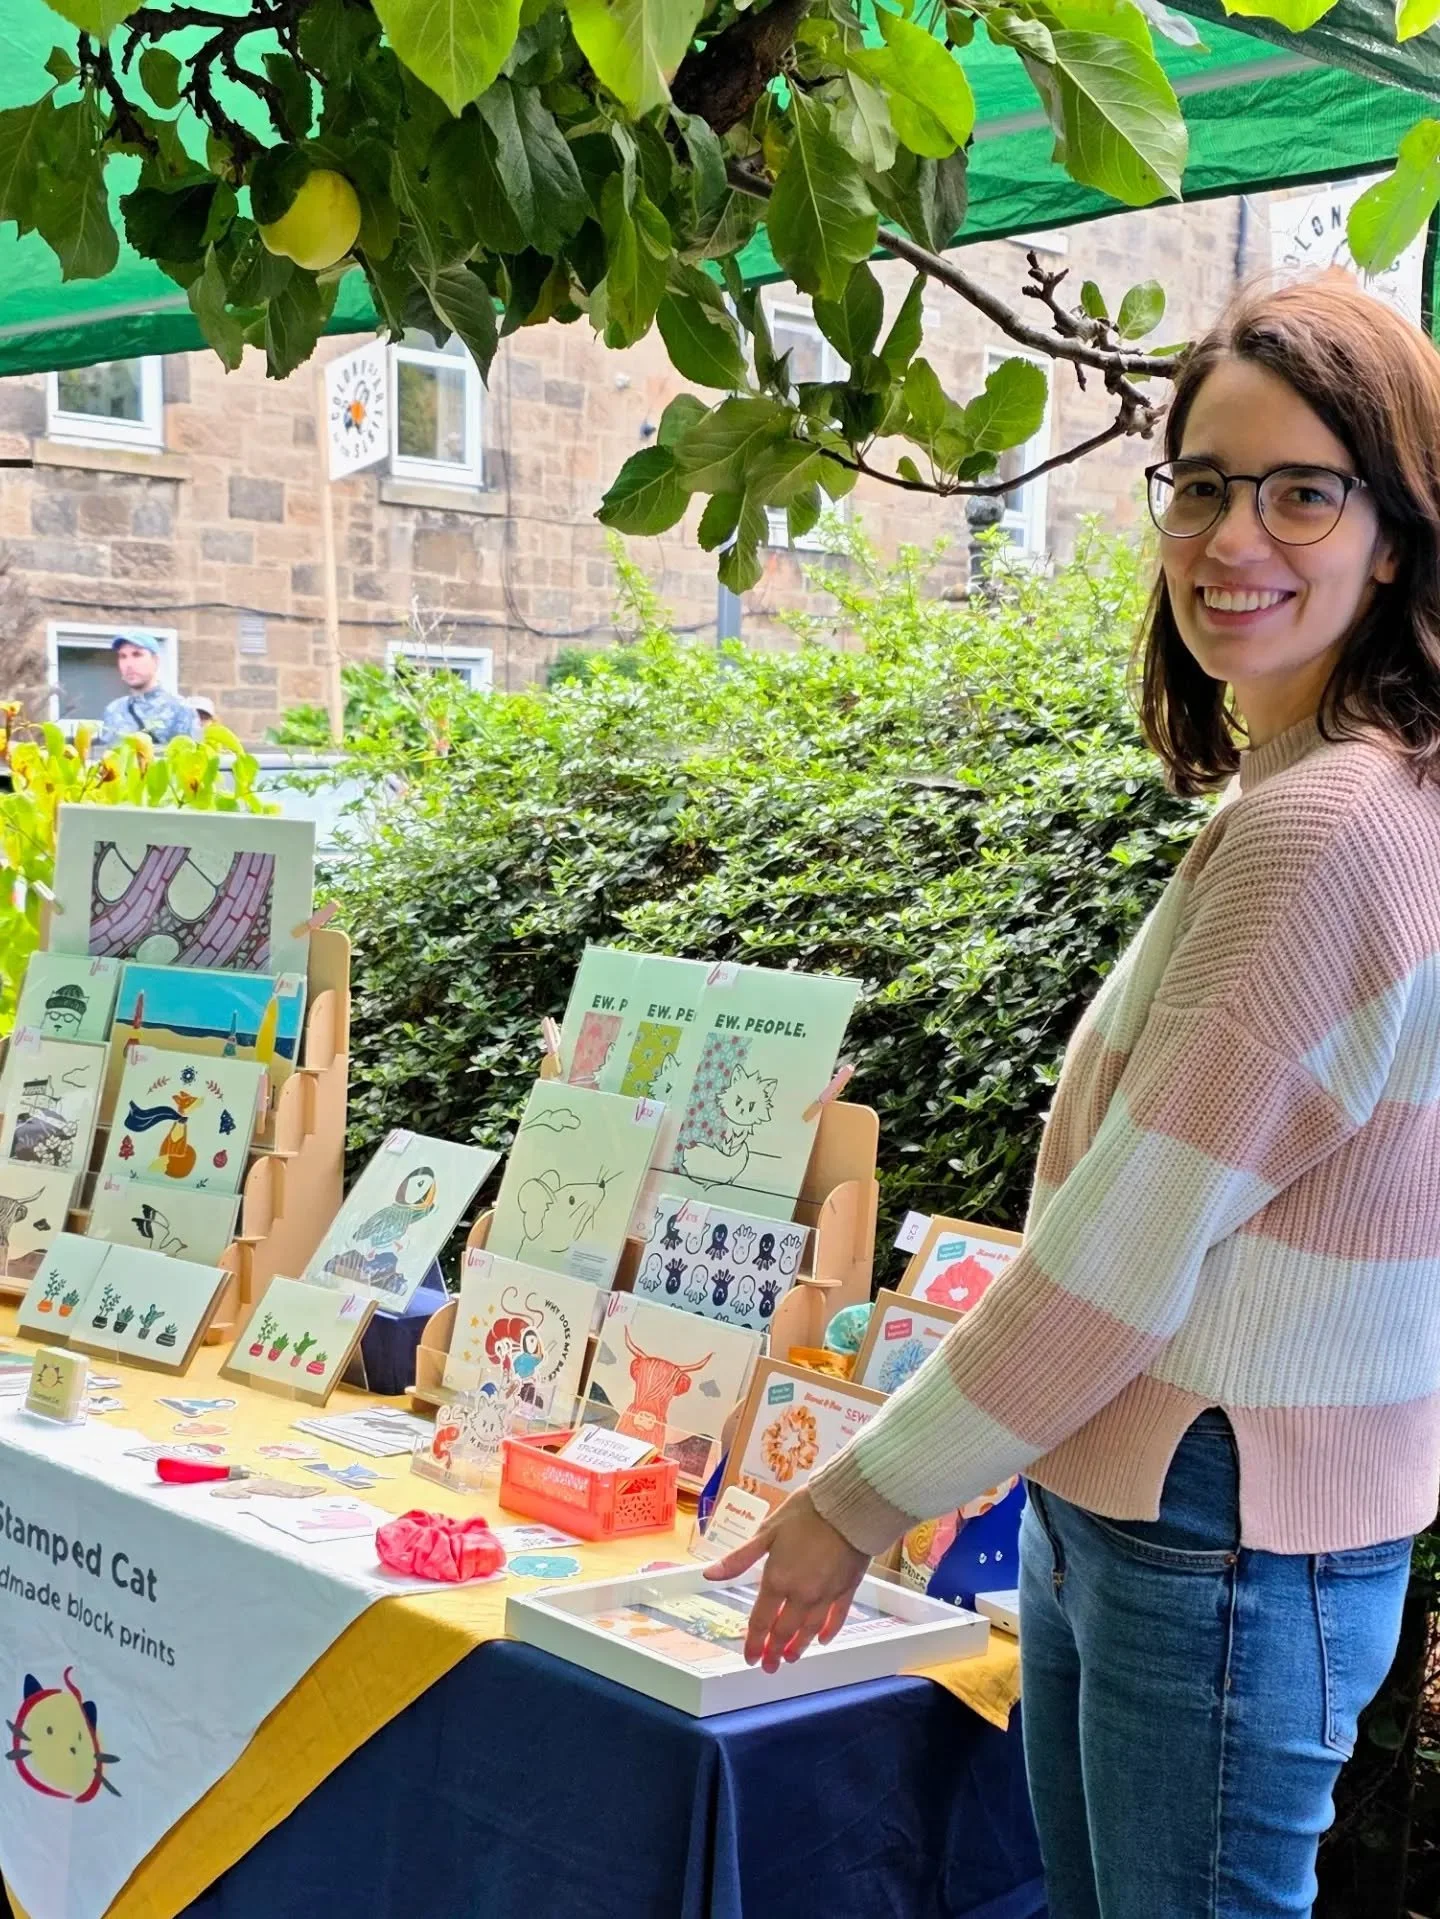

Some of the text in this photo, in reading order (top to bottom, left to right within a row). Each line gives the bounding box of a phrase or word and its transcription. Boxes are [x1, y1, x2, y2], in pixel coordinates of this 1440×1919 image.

[591, 994, 615, 1011] EW.
[646, 1003, 672, 1020] EW.
[714, 1013, 741, 1031] EW.
[744, 1017, 807, 1039] PEOPLE.
[544, 1299, 561, 1316] WHY
[559, 1314, 571, 1340] DOES
[561, 1342, 571, 1361] MY
[111, 1552, 158, 1603] Cat
[67, 1592, 114, 1639] block
[119, 1625, 176, 1666] prints
